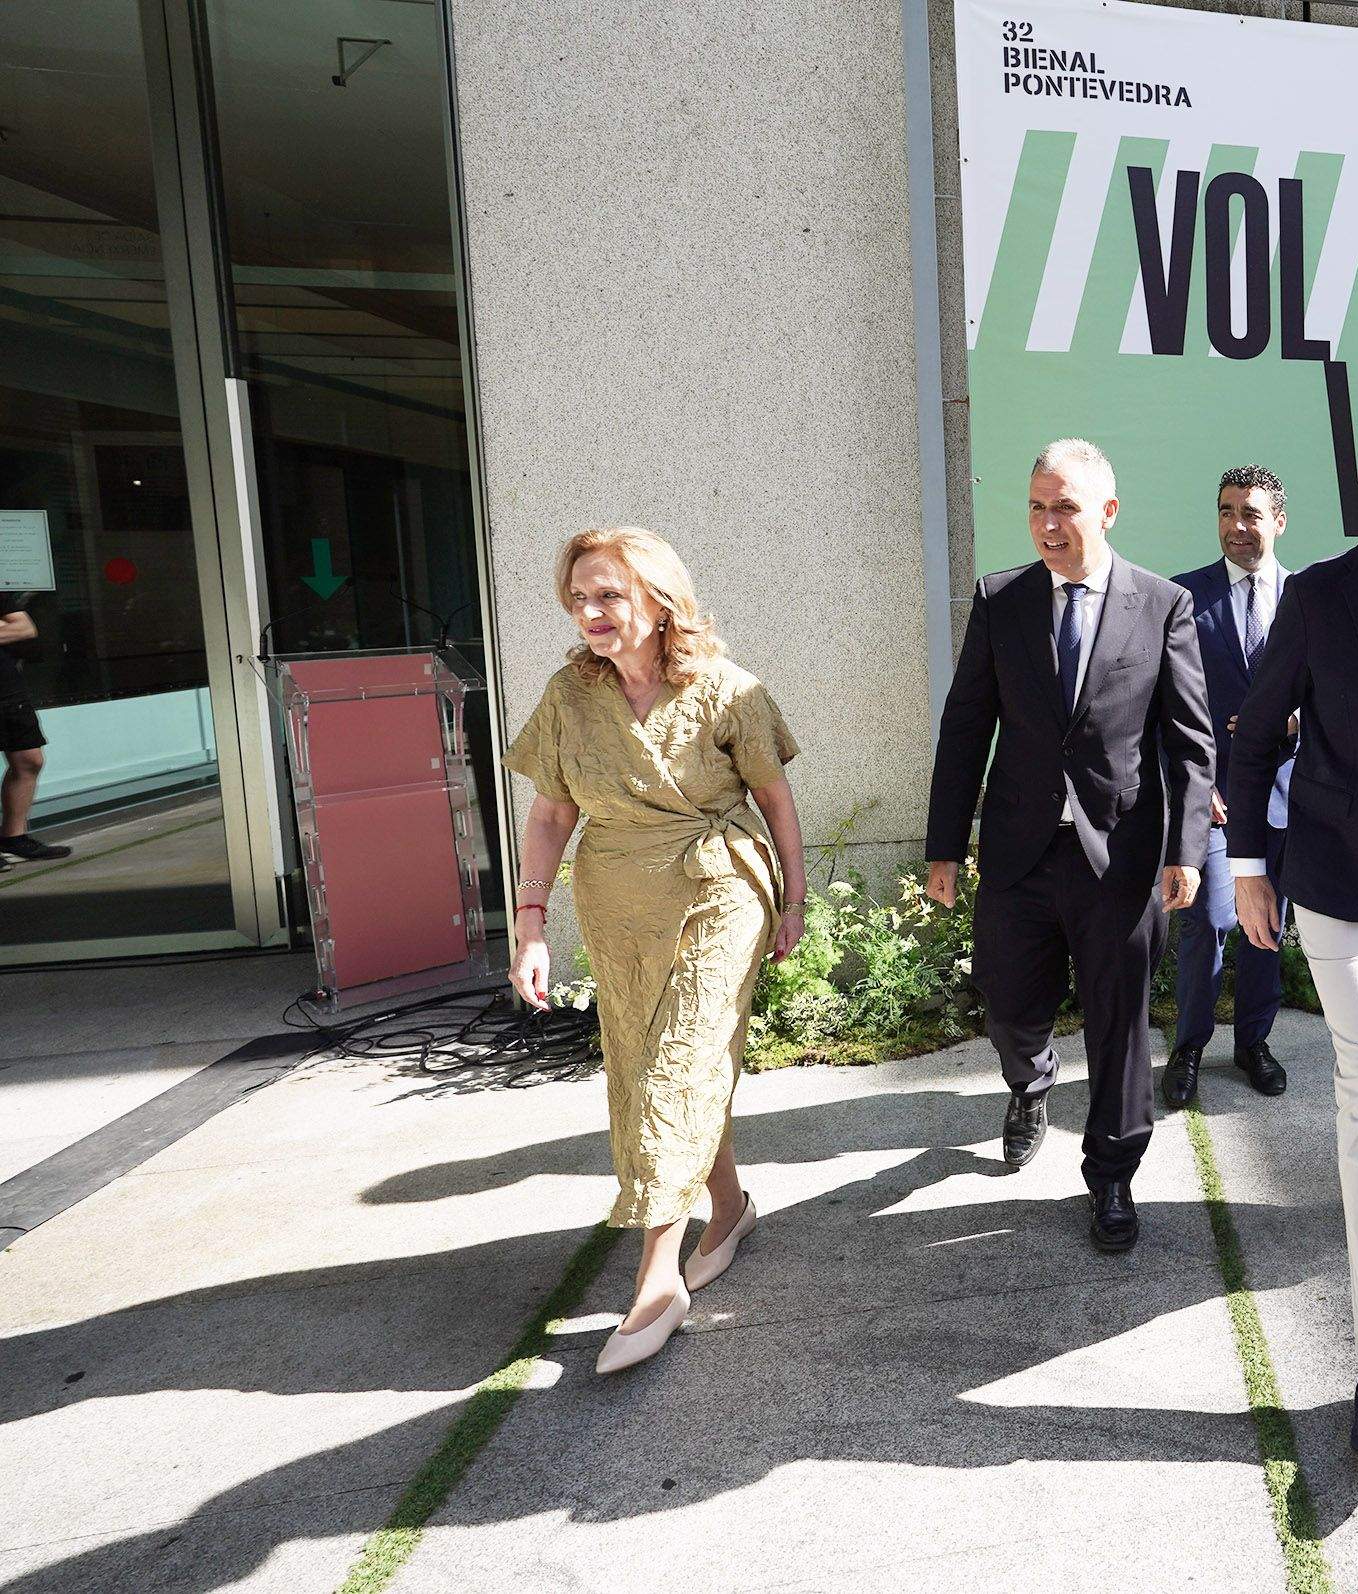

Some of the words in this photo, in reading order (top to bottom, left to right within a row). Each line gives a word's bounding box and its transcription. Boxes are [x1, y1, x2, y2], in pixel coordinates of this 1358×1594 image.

[1002, 20, 1034, 43] 32
[1003, 46, 1105, 74] BIENAL
[1004, 72, 1192, 108] PONTEVEDRA
[1126, 166, 1331, 361] VOL
